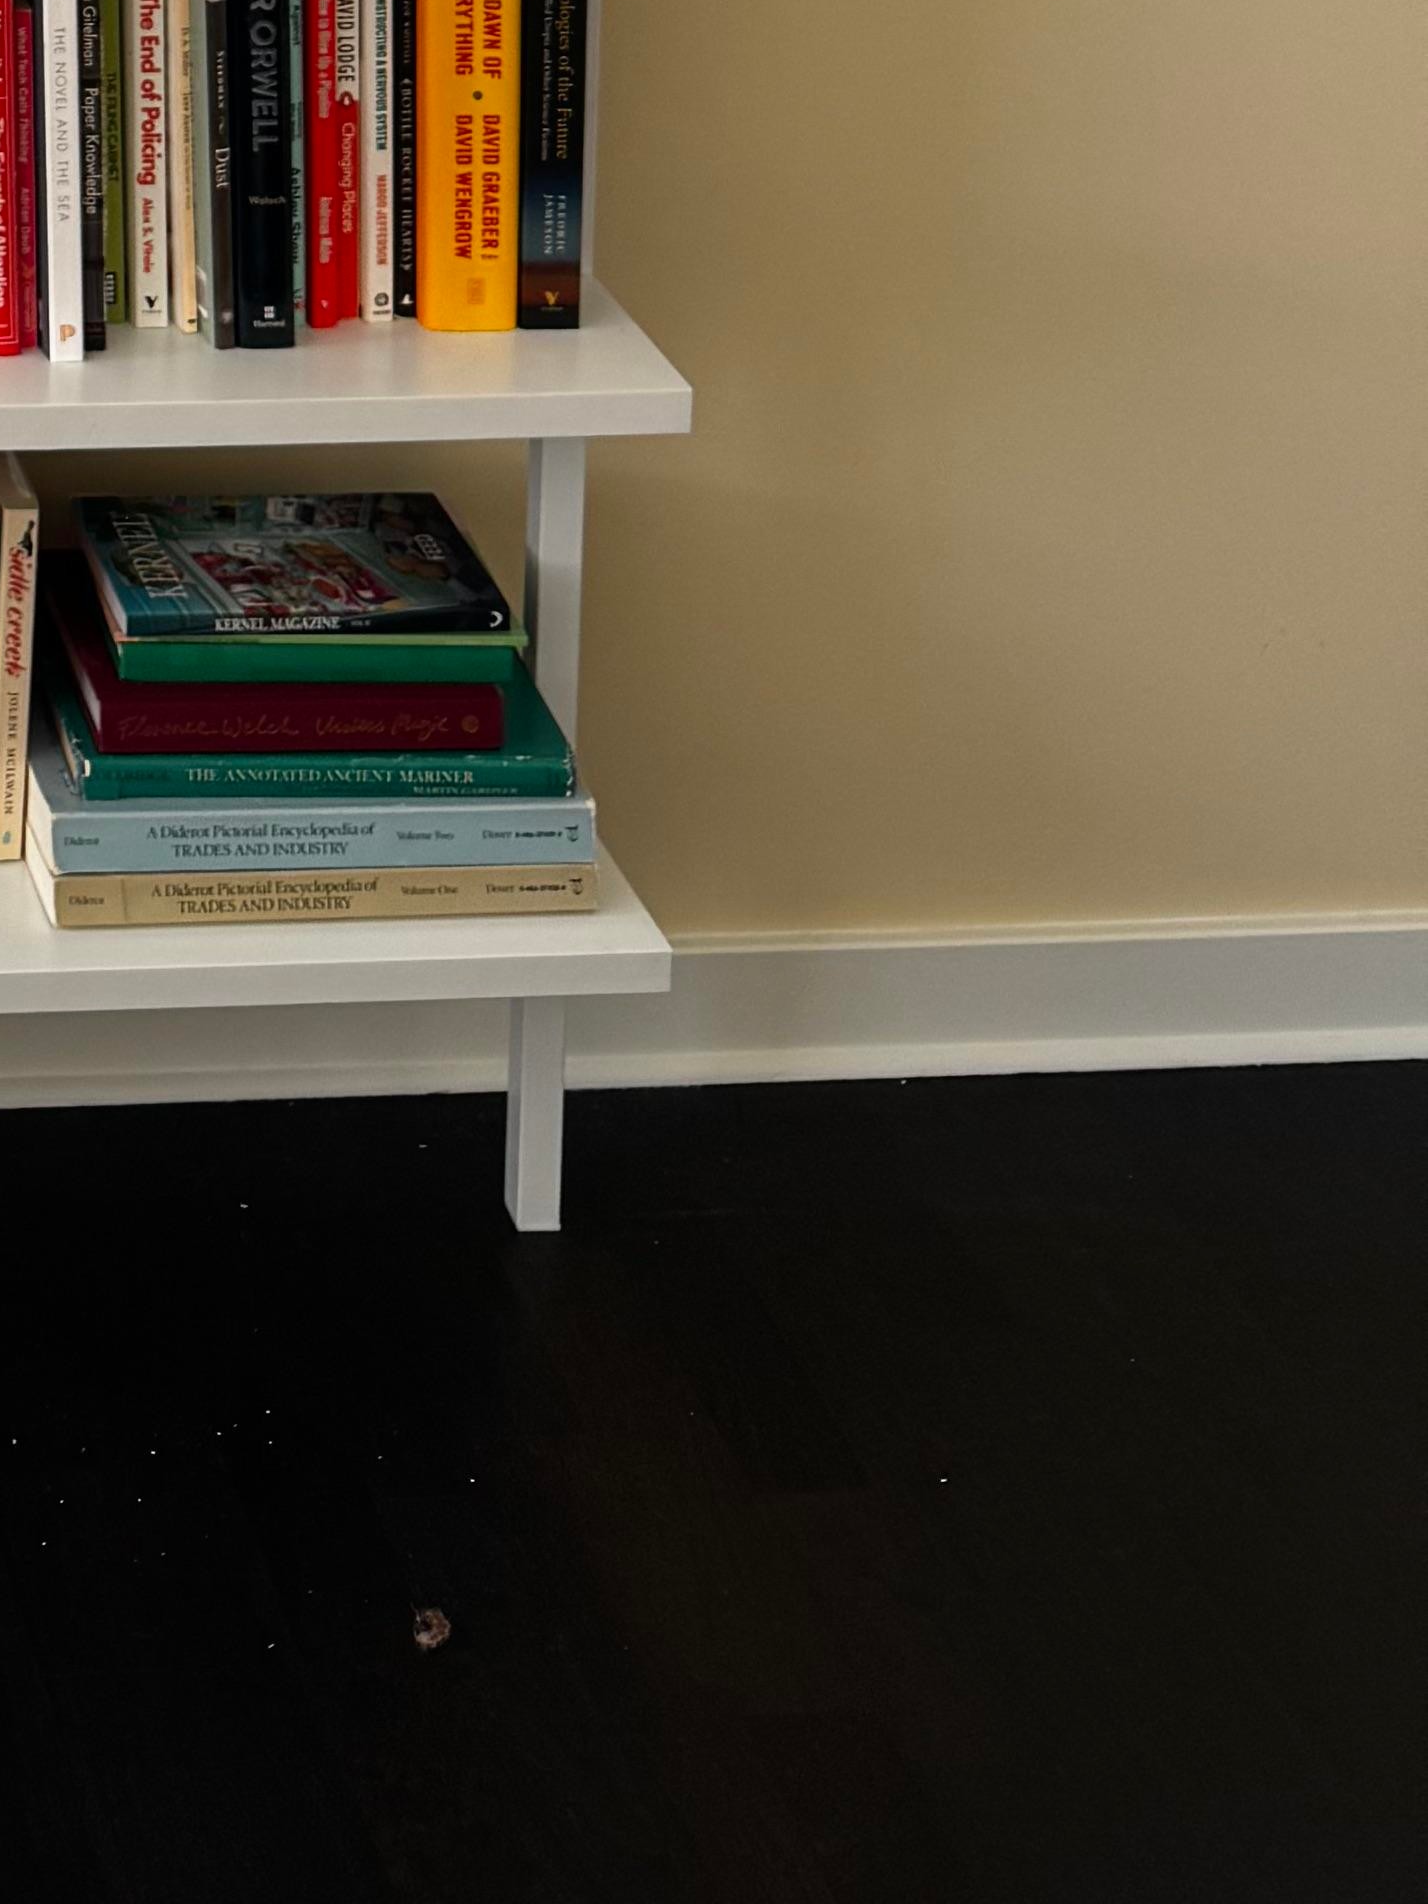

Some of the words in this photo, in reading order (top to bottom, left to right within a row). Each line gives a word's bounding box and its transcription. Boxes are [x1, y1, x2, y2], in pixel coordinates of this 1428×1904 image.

[139, 35, 162, 74] End
[483, 57, 502, 81] OF
[141, 79, 163, 101] of
[249, 18, 279, 152] ORWELL
[139, 105, 164, 187] Policing
[454, 115, 472, 166] DAVID
[482, 115, 500, 165] DAVID
[453, 172, 473, 260] WENGROW
[481, 171, 499, 249] GRAEBER
